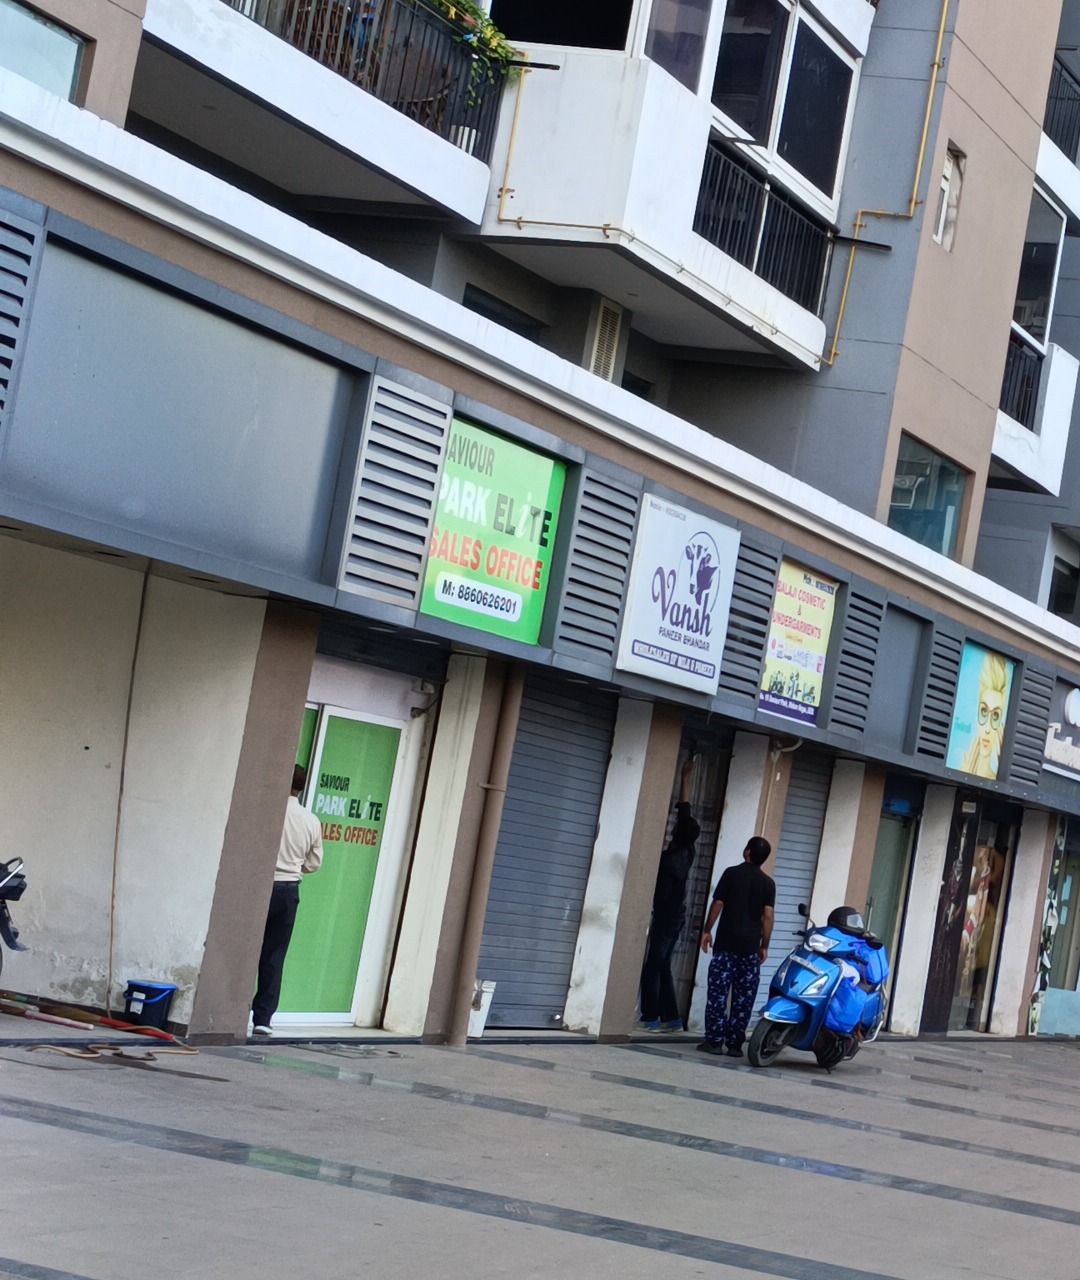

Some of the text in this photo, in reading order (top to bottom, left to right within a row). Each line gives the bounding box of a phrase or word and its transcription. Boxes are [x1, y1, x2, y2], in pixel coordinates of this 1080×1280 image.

[446, 433, 496, 477] AVIOUR
[429, 524, 544, 590] SALES OFFICE
[457, 584, 517, 615] 8860626201
[651, 566, 713, 639] Vansh
[797, 589, 827, 610] COSMETIC
[658, 626, 710, 651] PANEER BHANDAR
[772, 611, 822, 640] UNDERGARMENTS
[320, 773, 350, 793] SAVIOUR
[315, 793, 348, 818] PARK
[344, 825, 379, 847] OFFICE
